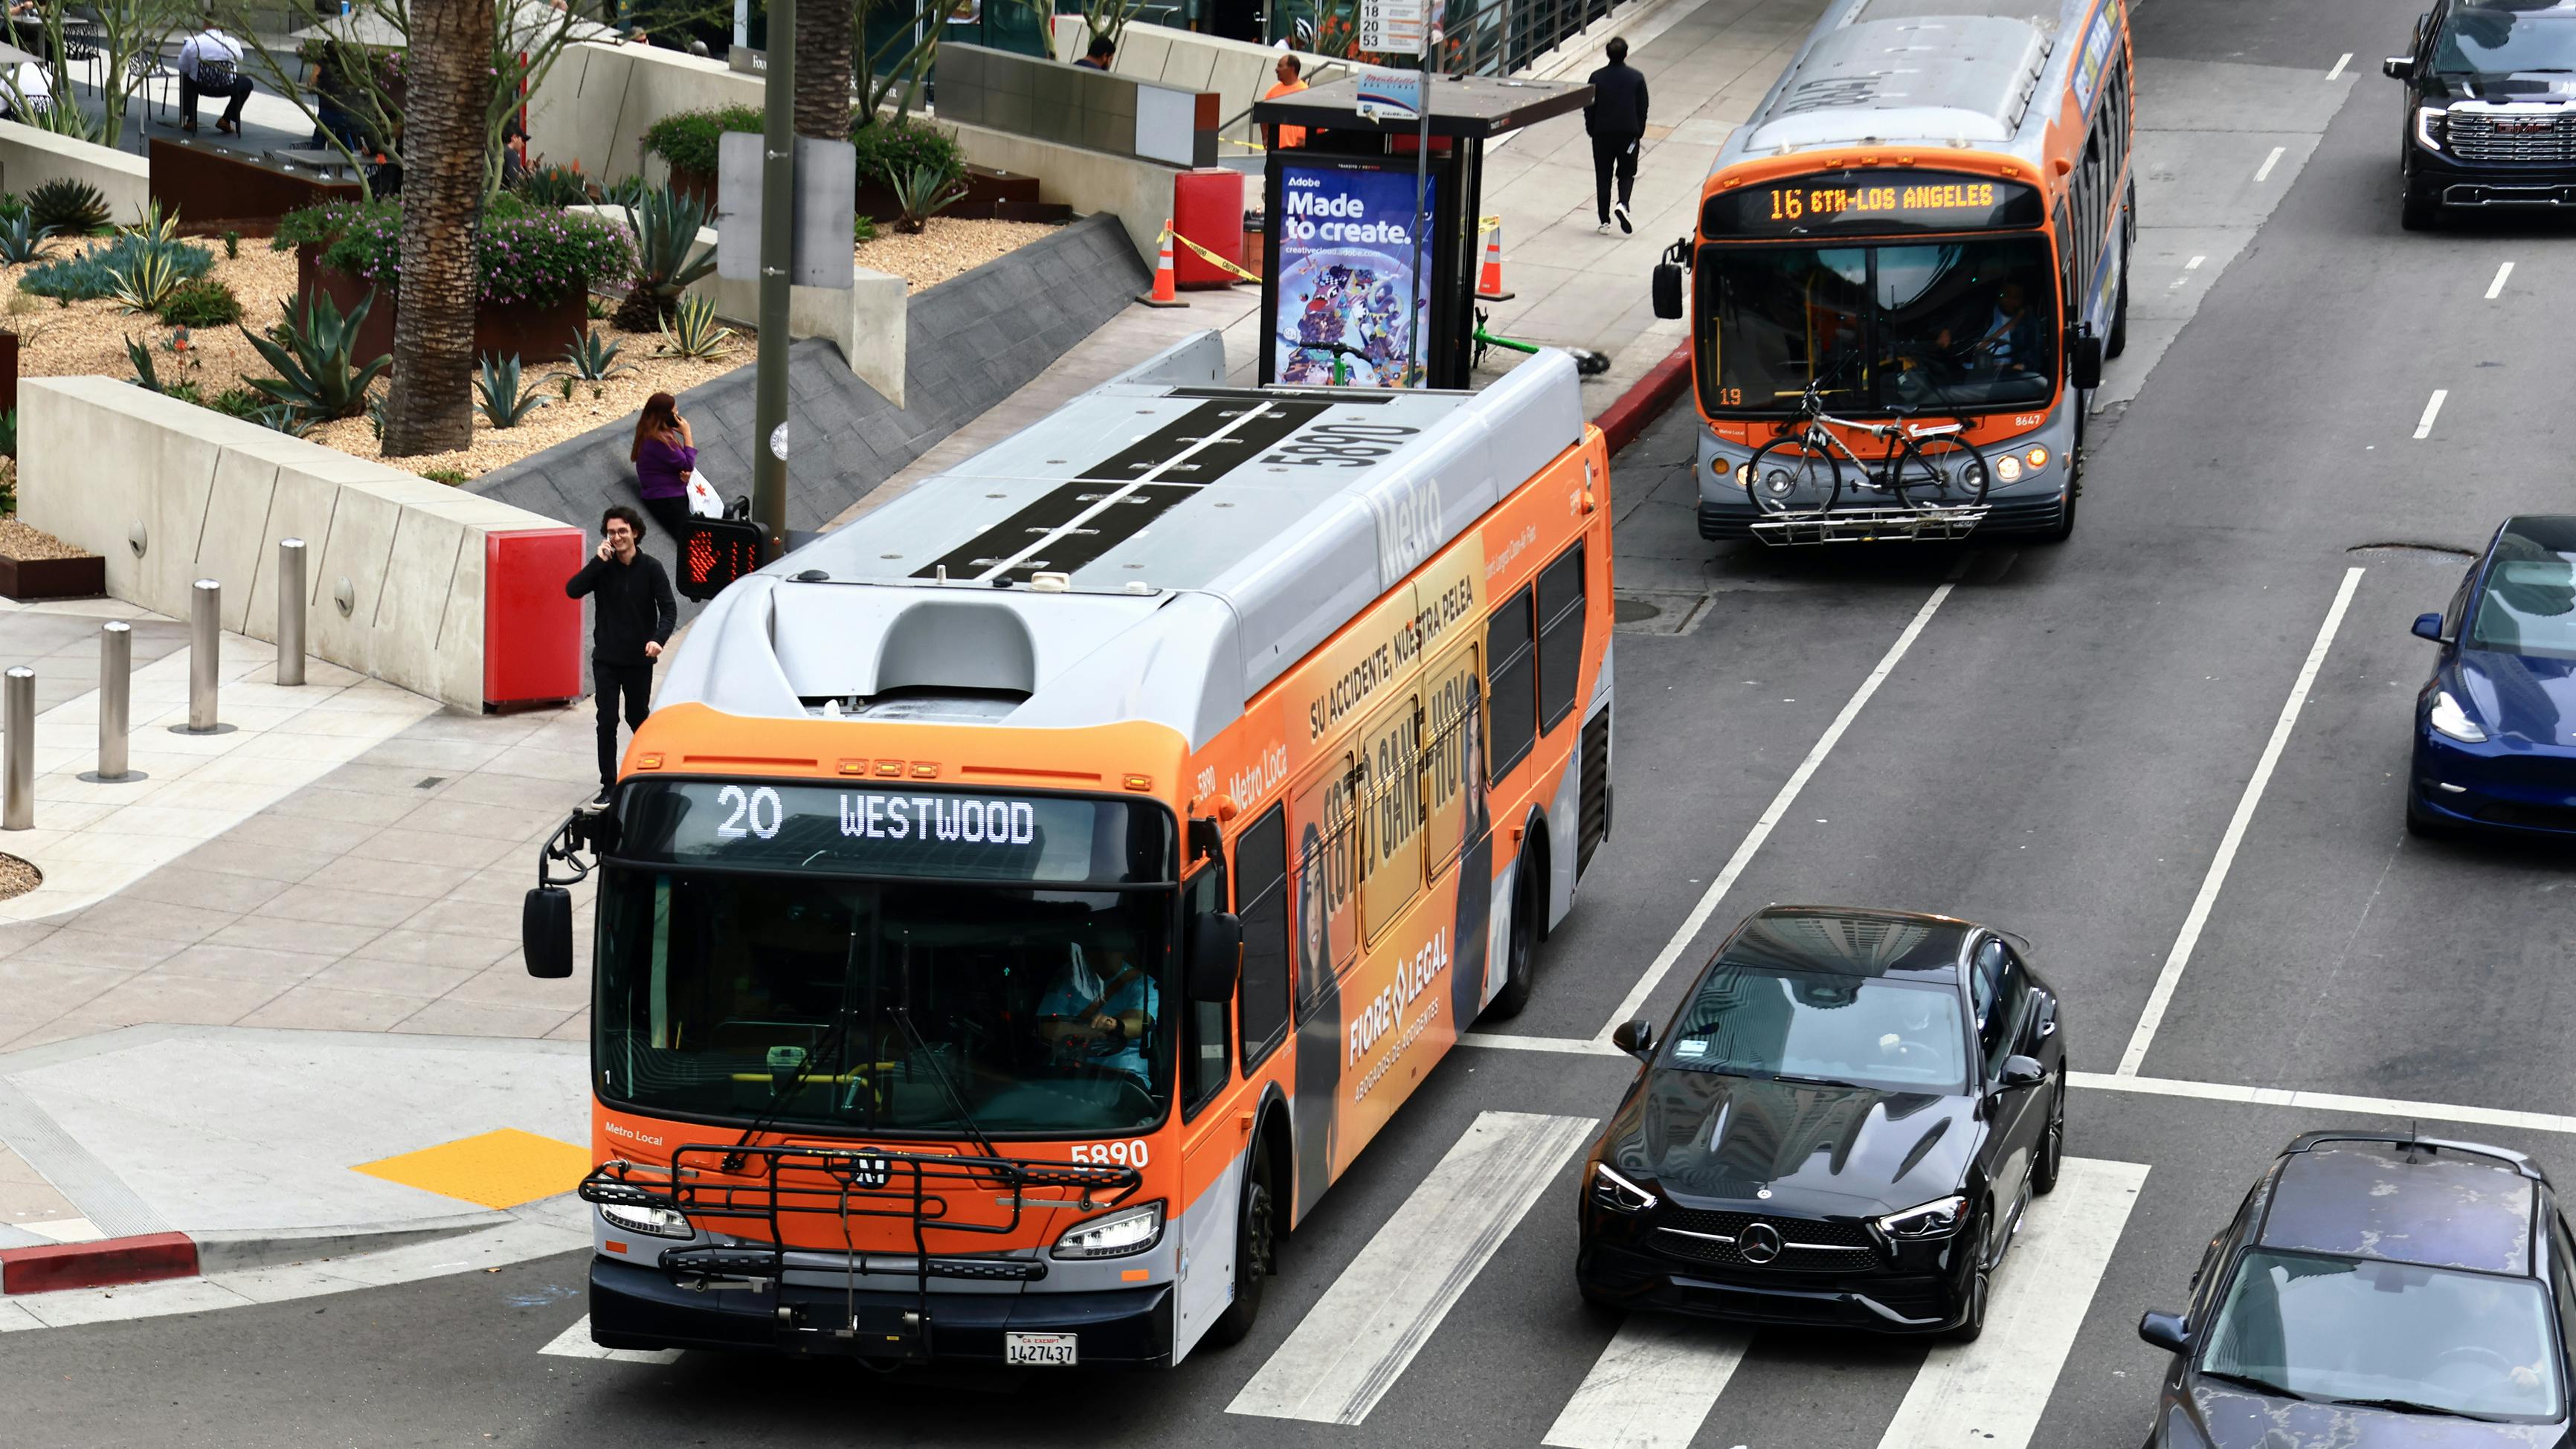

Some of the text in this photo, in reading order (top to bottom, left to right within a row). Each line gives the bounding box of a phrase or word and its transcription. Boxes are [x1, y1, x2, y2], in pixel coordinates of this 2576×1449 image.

[1364, 6, 1379, 18] 18
[1363, 20, 1379, 33] 20
[1362, 35, 1379, 47] 53
[2497, 123, 2553, 133] GMC
[1287, 177, 1321, 187] Adobe
[1287, 190, 1365, 219] Made
[1770, 188, 1803, 219] 16
[1902, 183, 1994, 210] ANGELES
[1285, 216, 1412, 245] to create.
[1285, 246, 1381, 258] creativecloud.adobe.com
[1222, 260, 1240, 274] CAUTION
[1719, 387, 1742, 406] 19
[2015, 415, 2041, 427] 8647
[1258, 424, 1421, 468] 5890
[1373, 475, 1443, 585] Metro
[1310, 574, 1474, 740] SU ACCIDENTE, NUESTRA PELEA
[1197, 743, 1287, 813] 5890 Metro Loca
[717, 784, 1034, 845] 20 WESTWOOD
[1349, 926, 1448, 1068] FIORE LEGAL
[1353, 996, 1439, 1106] ABOGADOS DE ACCIDENTES
[605, 1069, 611, 1085] 1
[605, 1121, 663, 1146] Metro Local
[1071, 1139, 1149, 1172] 5890
[1010, 1345, 1072, 1361] 1427437
